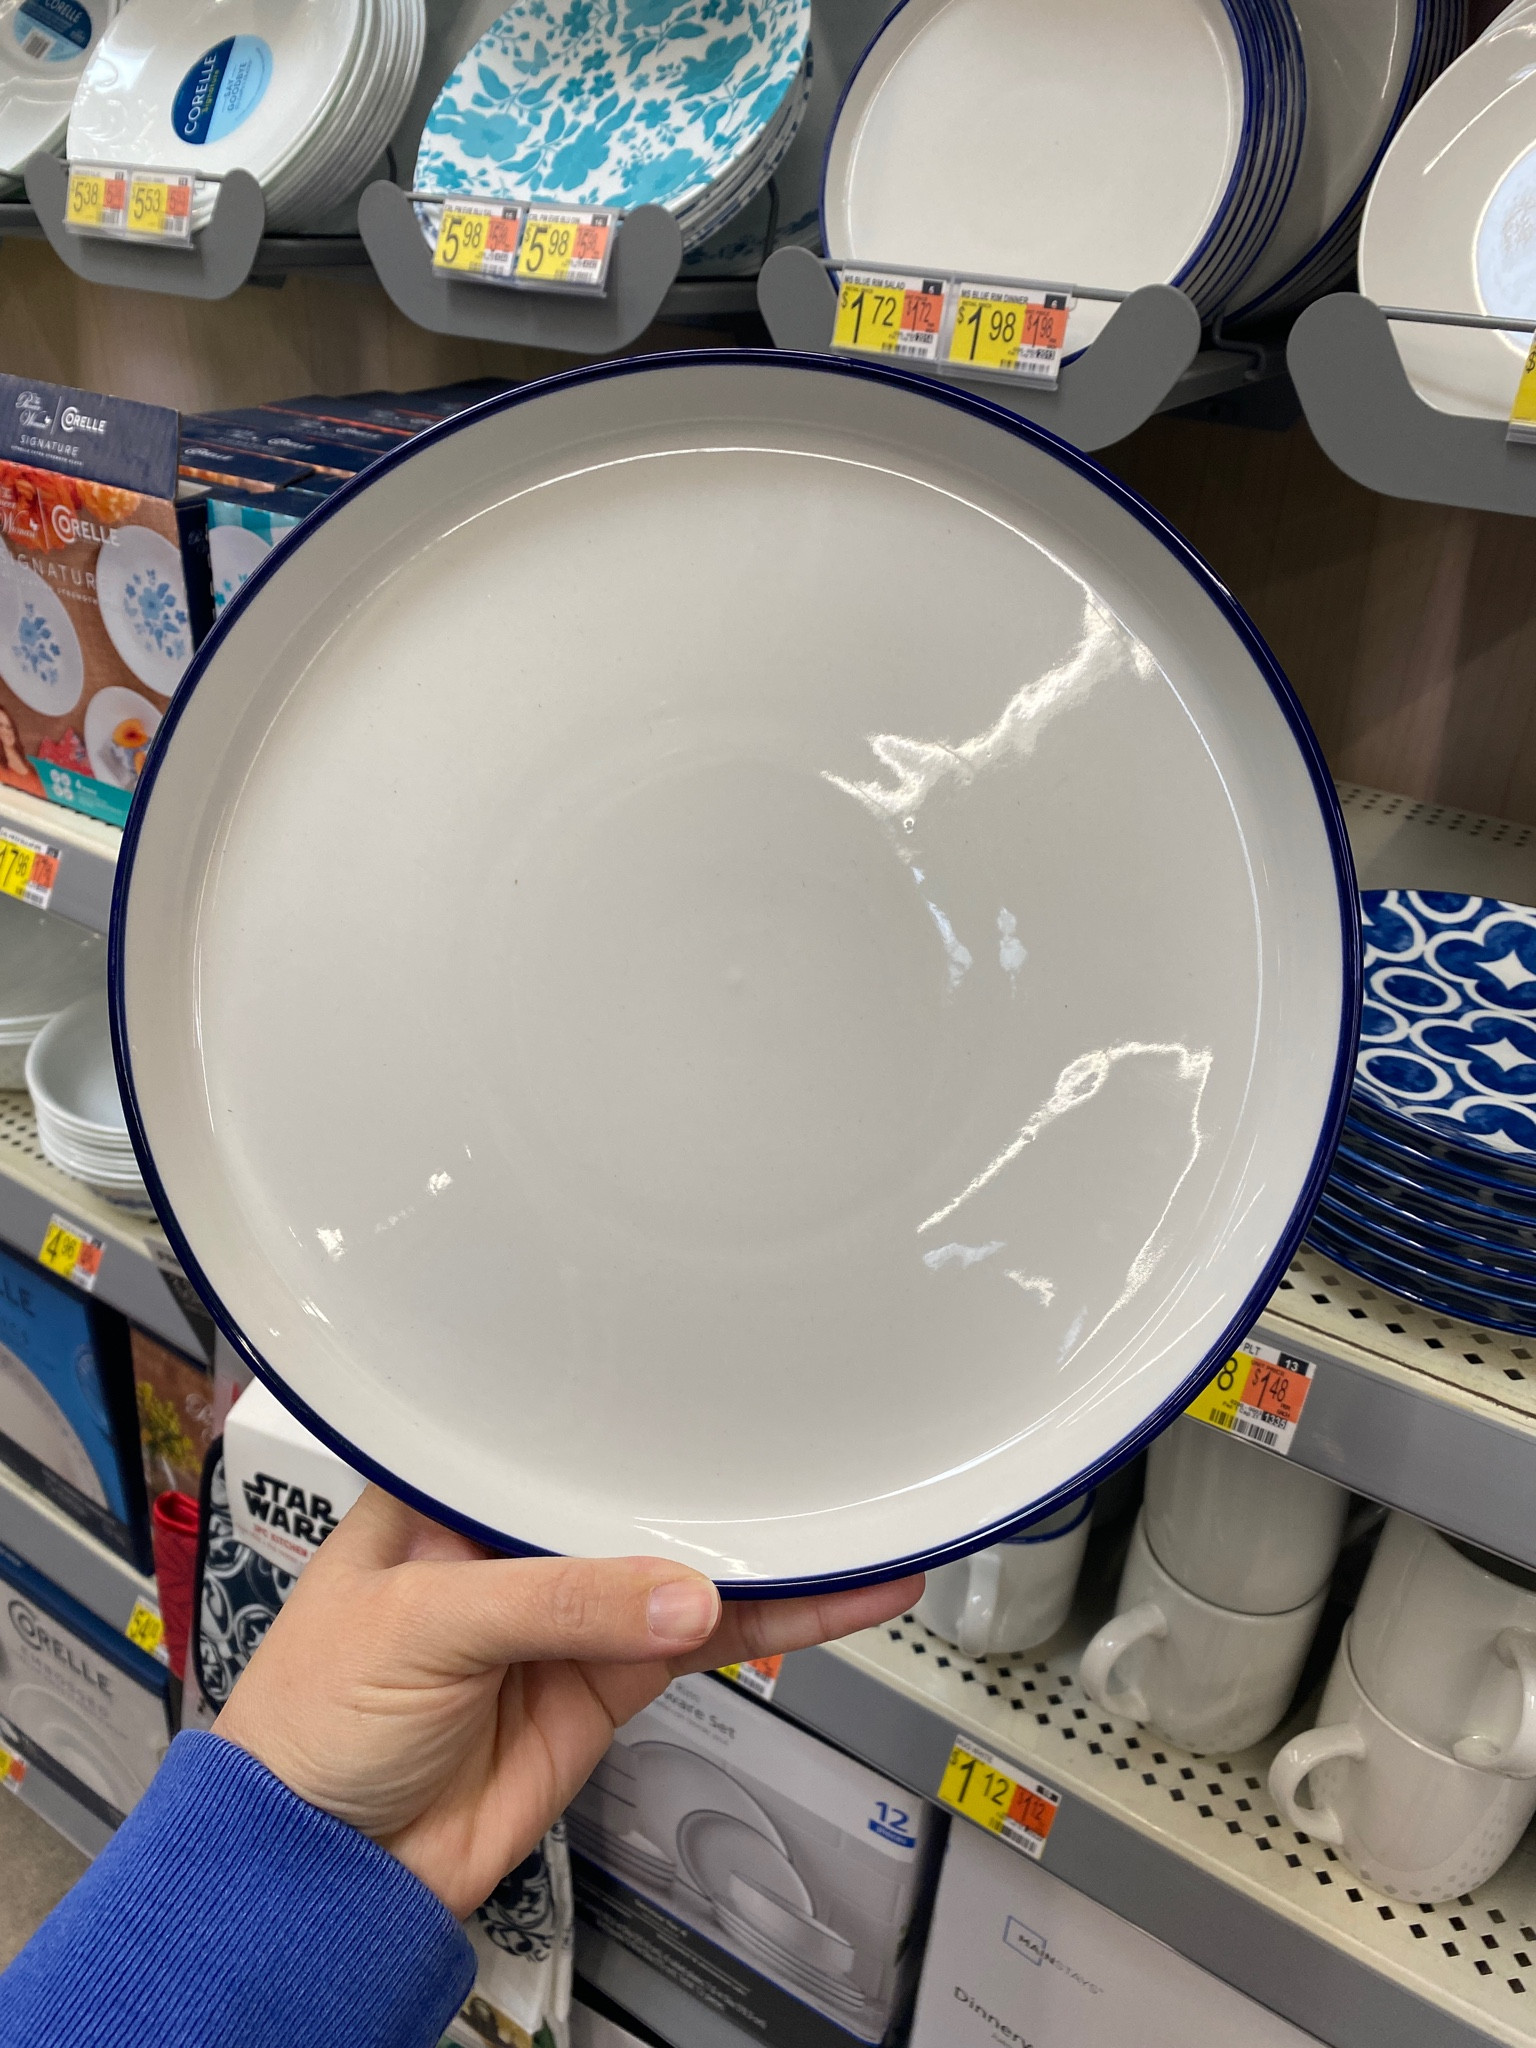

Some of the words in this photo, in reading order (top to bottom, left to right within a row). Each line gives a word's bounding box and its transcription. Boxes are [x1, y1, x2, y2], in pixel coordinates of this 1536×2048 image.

[184, 54, 217, 134] CORELLE
[855, 277, 871, 288] BLUE
[872, 279, 884, 288] RIM
[885, 280, 906, 290] SALAD
[972, 291, 990, 301] BLUE
[991, 293, 1003, 302] RIM
[1004, 295, 1029, 305] DINNER
[61, 406, 107, 434] CORELLE
[20, 434, 80, 458] SIGNATURE
[51, 504, 121, 547] CORELLE
[1243, 1342, 1261, 1355] PLT
[1285, 1359, 1299, 1371] 13
[1263, 1412, 1287, 1428] 1335
[242, 1471, 340, 1527] STAR
[243, 1489, 335, 1547] WARS
[8, 1600, 113, 1698] CORELLE
[708, 1713, 735, 1740] Set
[875, 1801, 909, 1833] 12
[1018, 1934, 1101, 1995] MAINSTAYS
